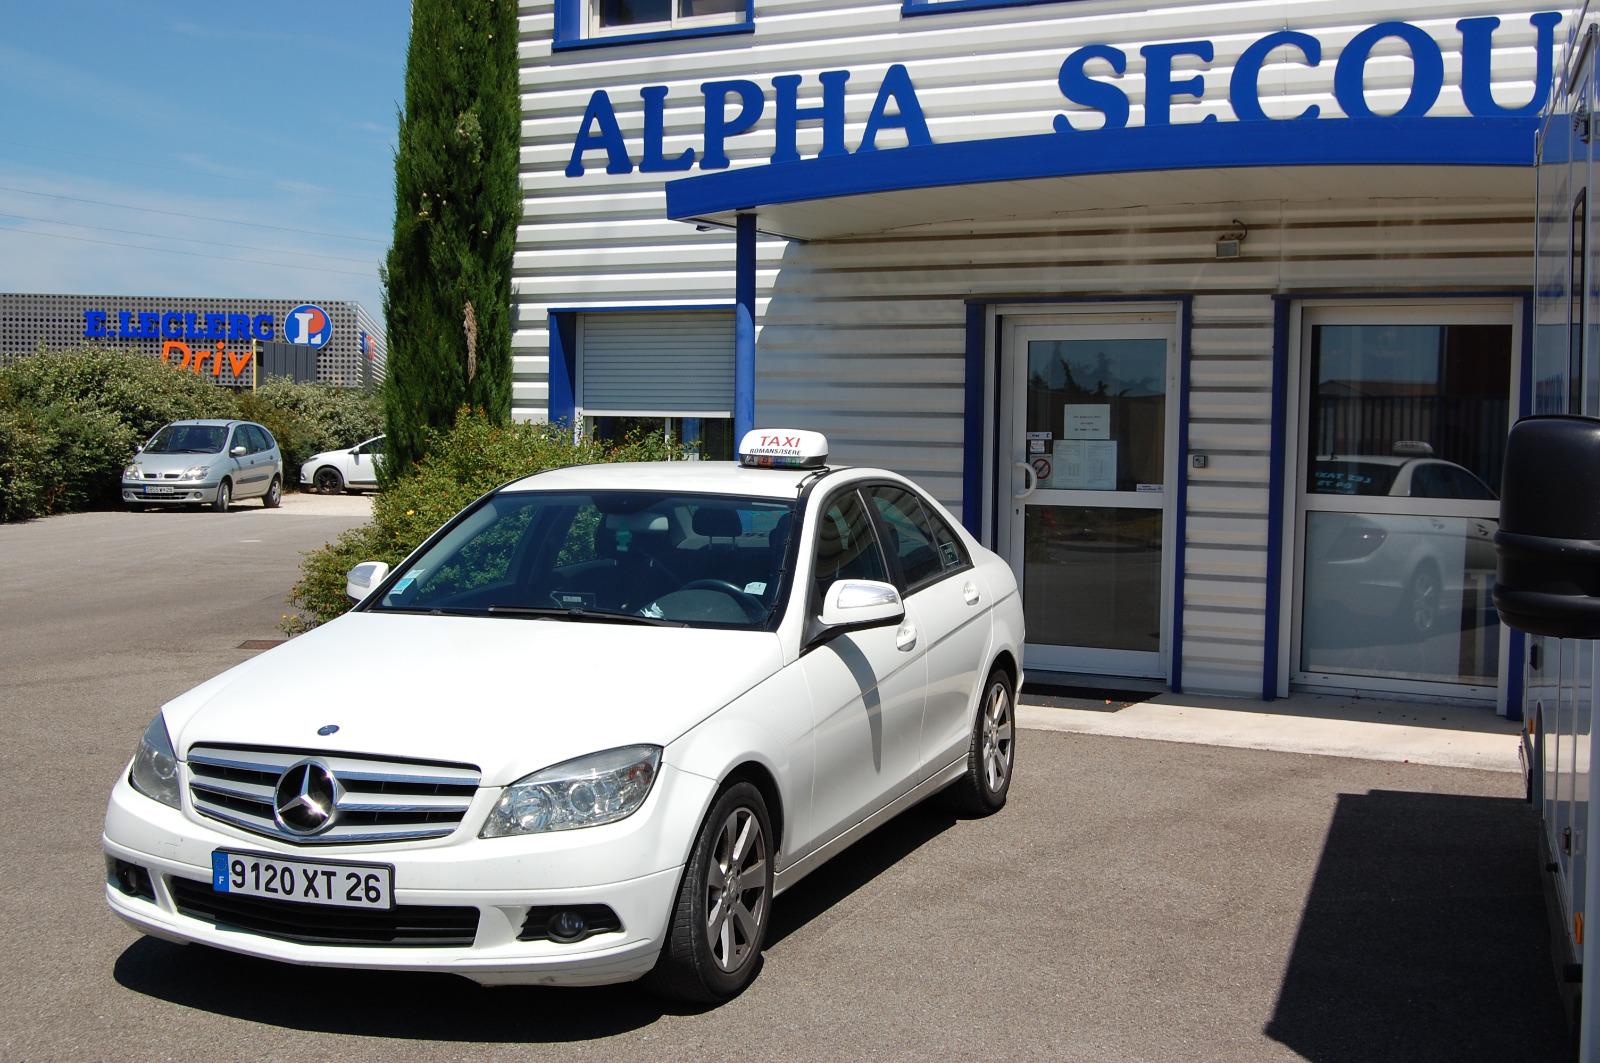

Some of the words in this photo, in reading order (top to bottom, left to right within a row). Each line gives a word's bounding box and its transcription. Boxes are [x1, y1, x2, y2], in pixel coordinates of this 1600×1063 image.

[565, 64, 932, 177] ALPHA
[84, 310, 275, 340] E.LECLERC
[760, 436, 801, 448] TAXI
[219, 876, 225, 885] F
[231, 859, 295, 896] 9120
[302, 868, 337, 899] XT
[345, 872, 381, 903] 26
